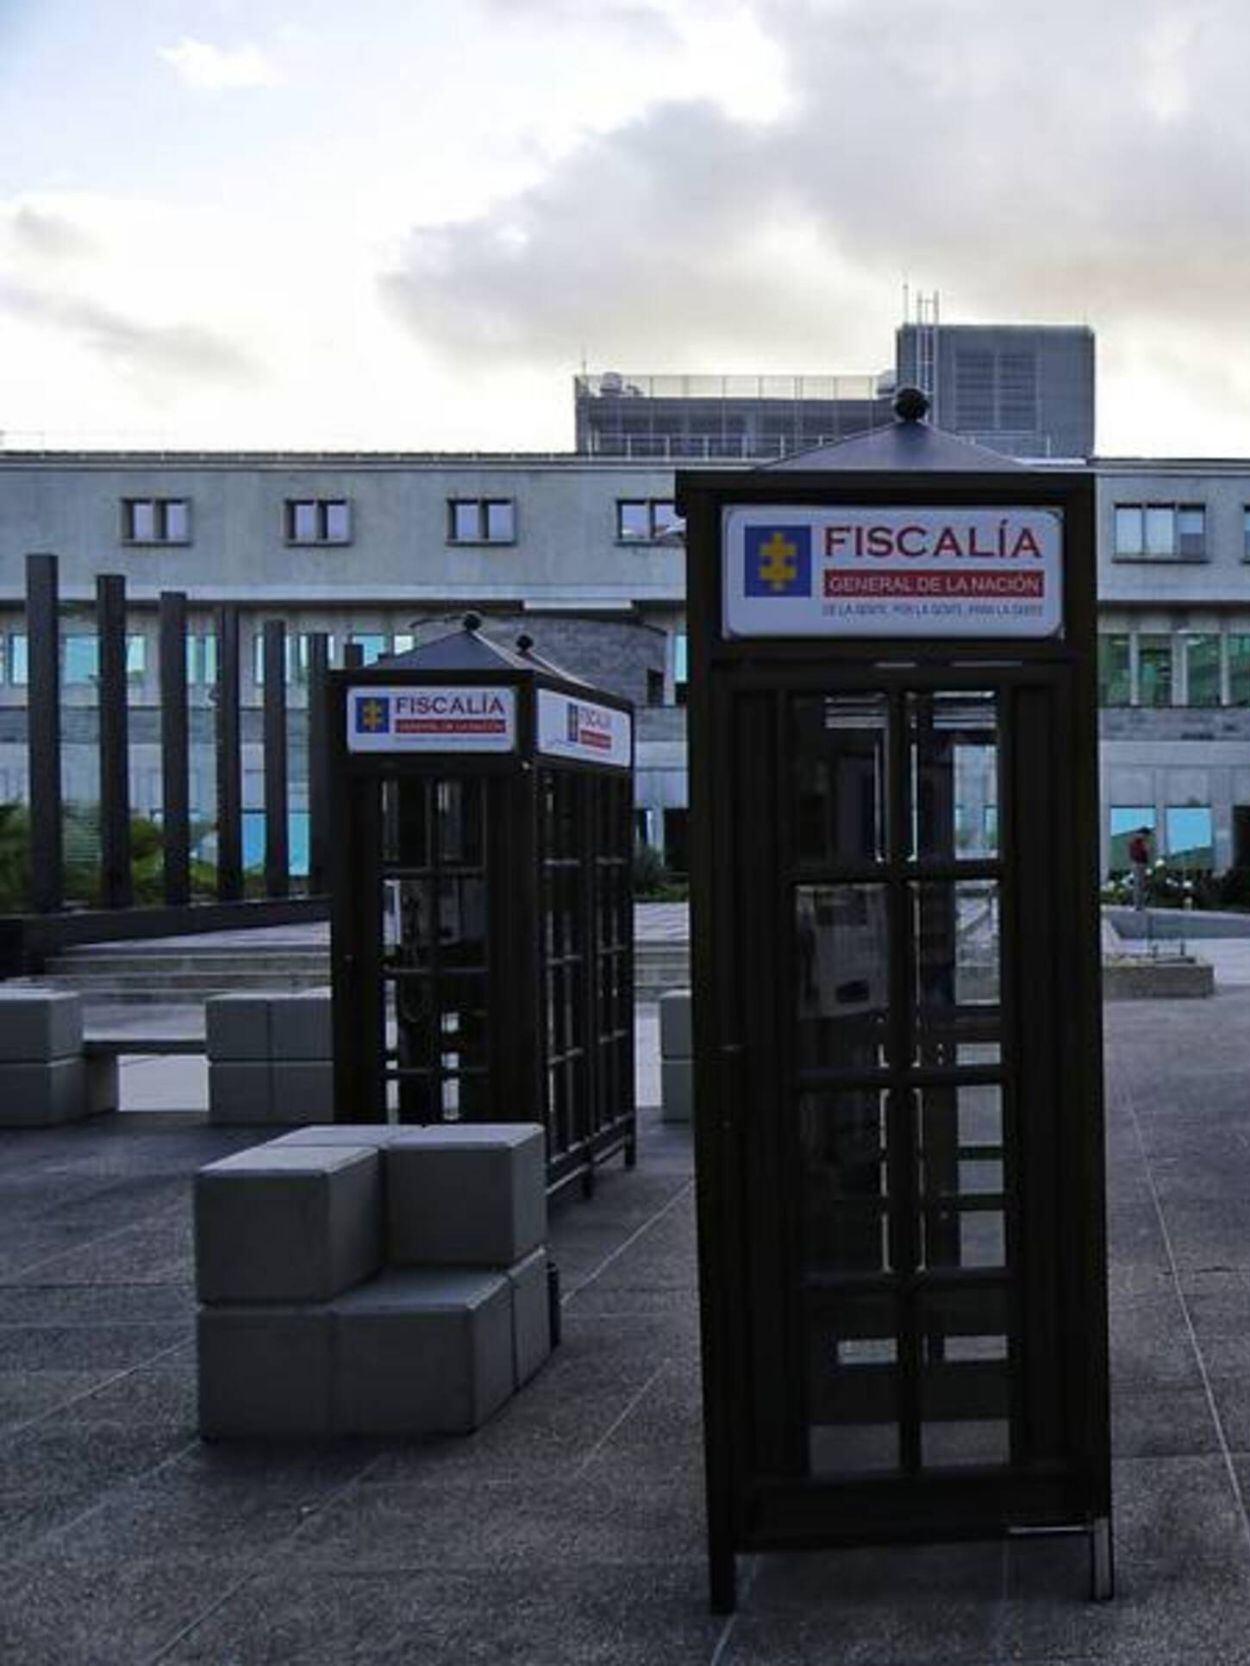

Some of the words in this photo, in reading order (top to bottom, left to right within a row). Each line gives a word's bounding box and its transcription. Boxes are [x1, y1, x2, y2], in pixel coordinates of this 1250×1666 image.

[824, 519, 1042, 559] FISCALÍA
[829, 576, 913, 593] GENERAL
[916, 576, 941, 593] DE
[946, 576, 967, 593] LA
[971, 571, 1039, 593] NACIÓN
